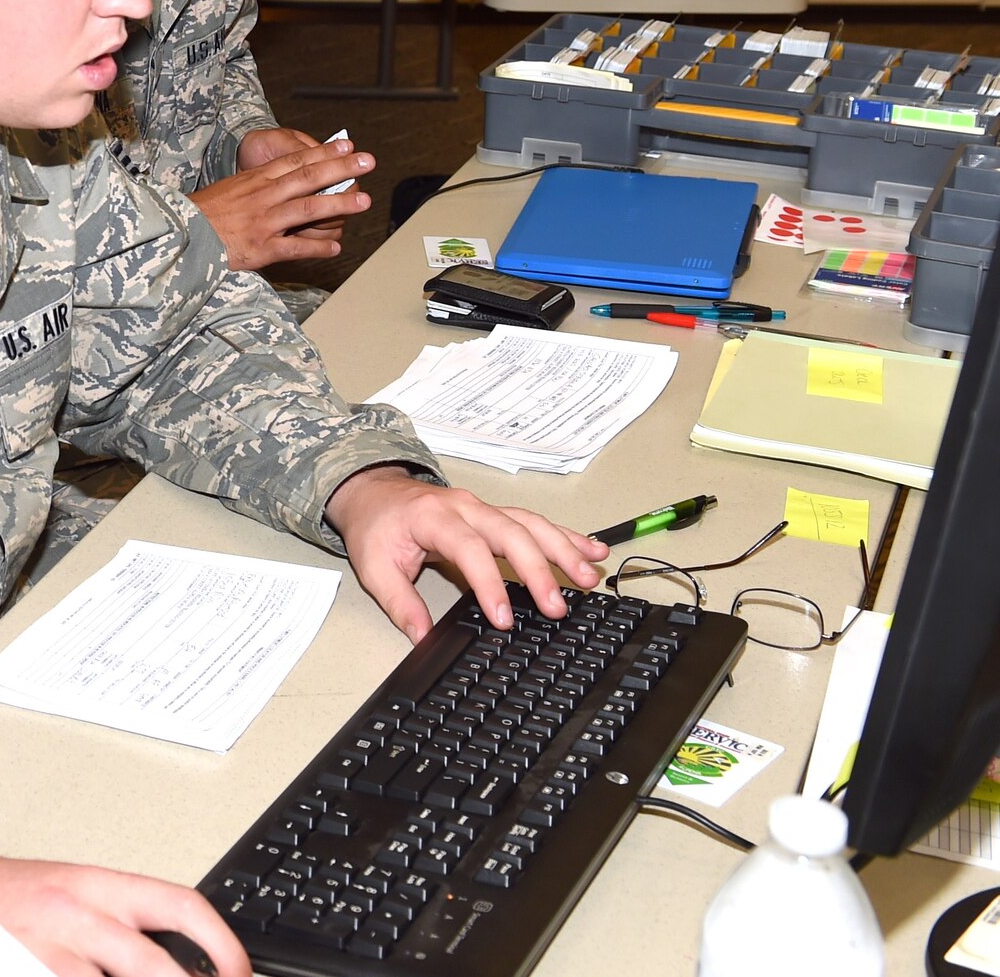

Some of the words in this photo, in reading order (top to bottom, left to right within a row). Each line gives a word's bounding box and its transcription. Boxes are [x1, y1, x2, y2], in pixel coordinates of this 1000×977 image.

[187, 41, 212, 65] U.S.
[2, 326, 37, 361] U.S.
[42, 302, 70, 343] AIR
[692, 727, 749, 752] ERVIC
[290, 872, 301, 880] 2
[380, 869, 392, 877] 7
[326, 879, 338, 887] 5
[274, 889, 286, 897] 3
[365, 886, 378, 895] 8
[312, 897, 324, 905] 6
[350, 905, 362, 913] 9
